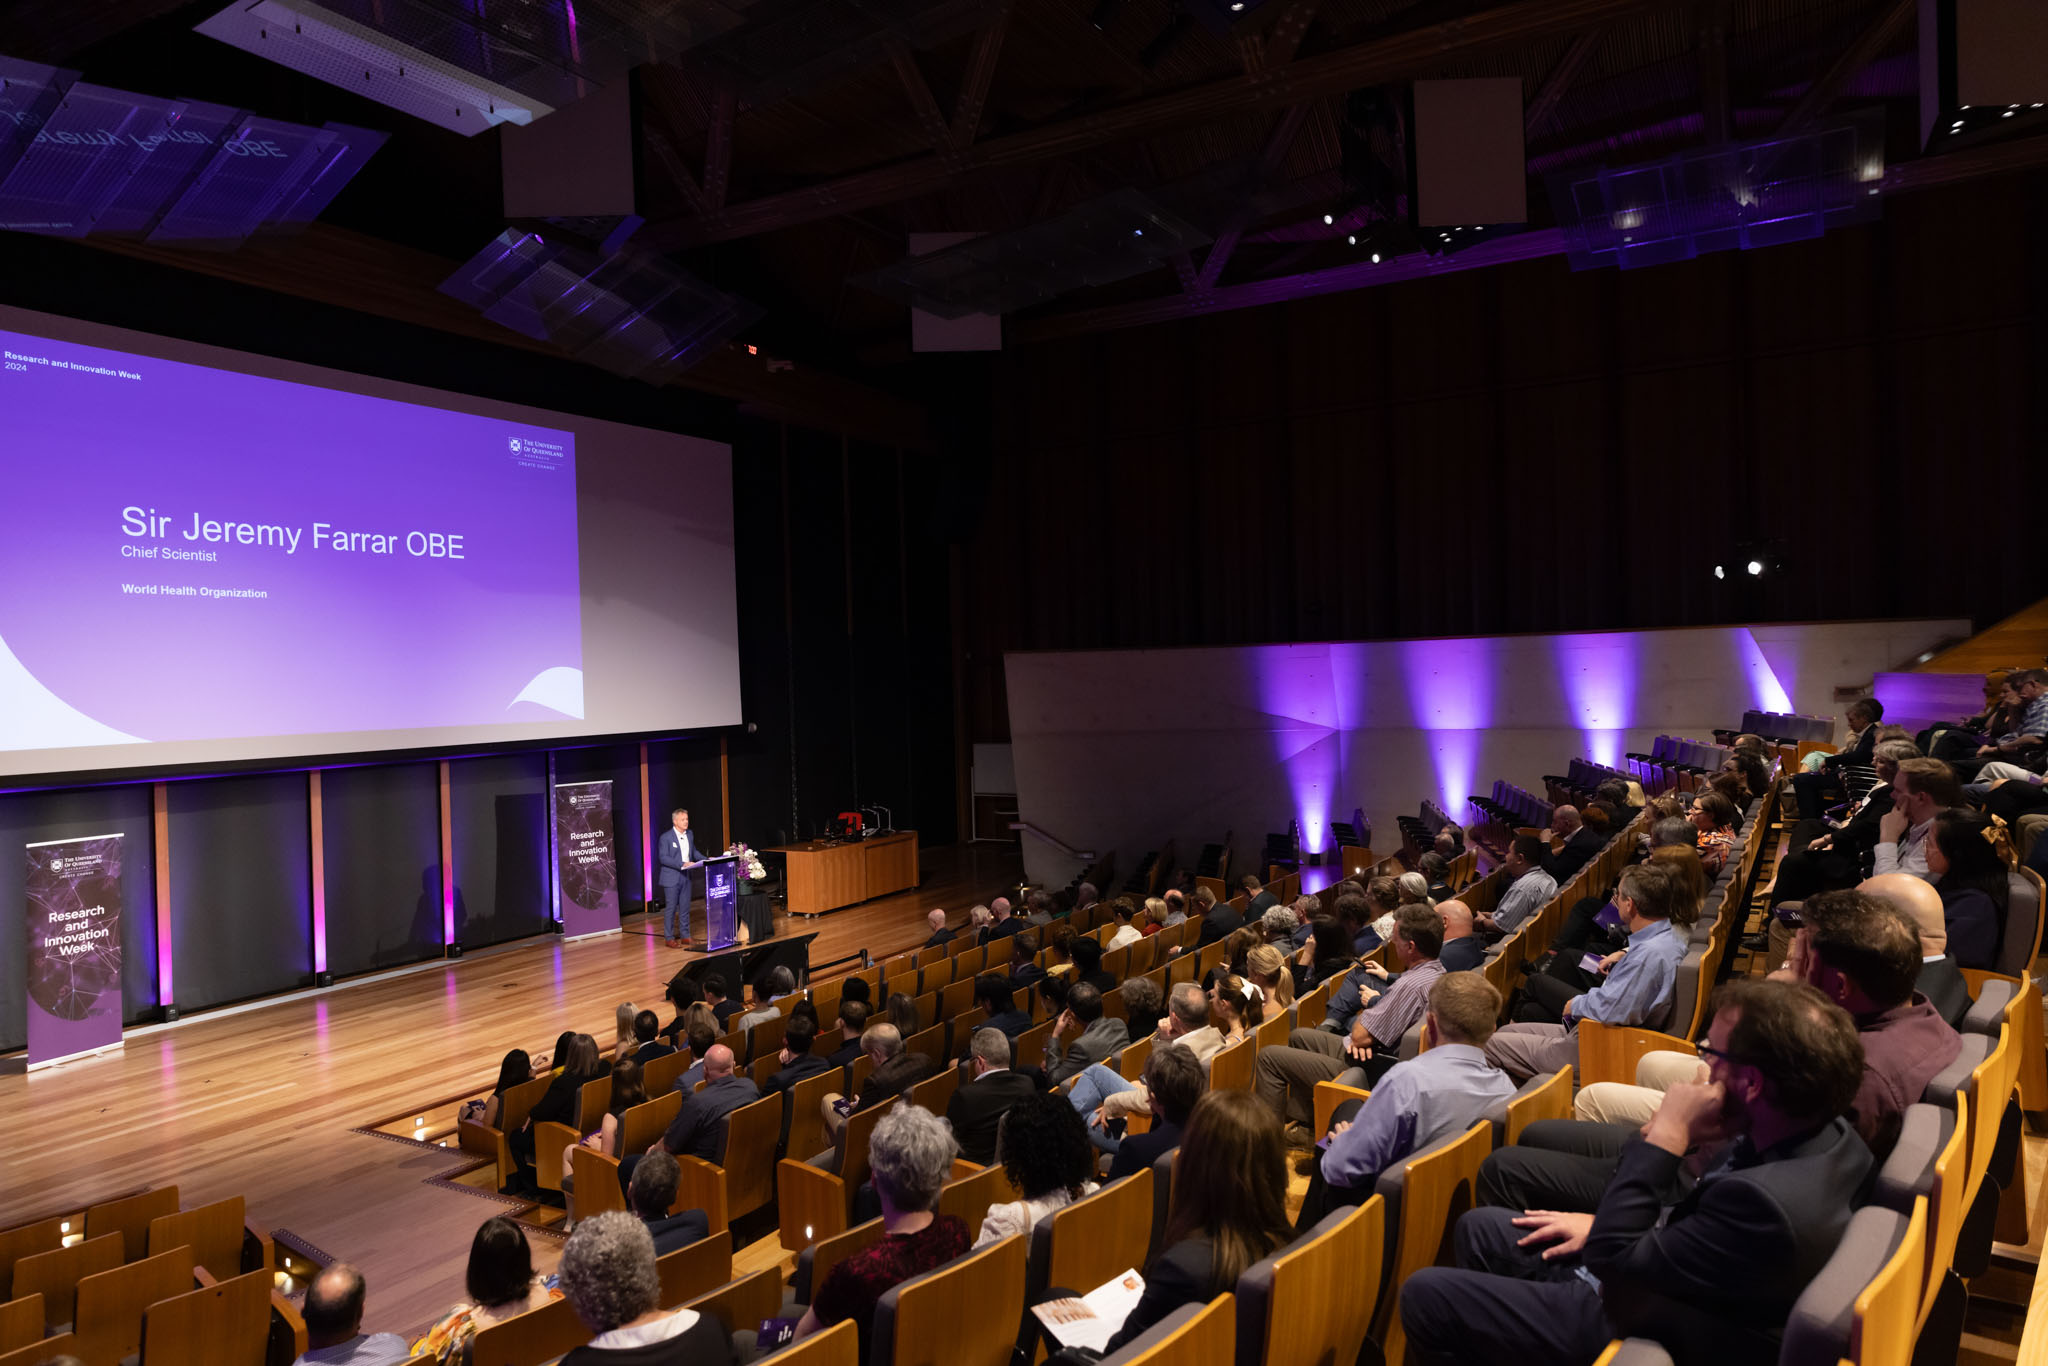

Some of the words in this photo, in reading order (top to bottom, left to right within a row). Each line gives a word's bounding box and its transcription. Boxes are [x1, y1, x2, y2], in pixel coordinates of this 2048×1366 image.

[4, 351, 49, 366] Research
[51, 359, 69, 369] and
[70, 362, 117, 377] Innovation
[118, 370, 142, 381] Week
[4, 361, 27, 372] 2024
[122, 506, 172, 538] Sir
[183, 512, 302, 554] Jeremy
[313, 522, 398, 554] Farrar
[406, 531, 465, 559] OBE
[121, 545, 159, 558] Chief
[161, 547, 217, 562] Scientist
[121, 583, 157, 595] World
[160, 585, 197, 596] Health
[199, 587, 268, 599] Organization
[570, 830, 604, 840] Research
[581, 839, 594, 847] and
[568, 846, 608, 857] Innovation
[578, 855, 599, 864] Week
[48, 905, 105, 923] Research
[65, 919, 88, 932] and
[44, 927, 109, 947] Innovation
[59, 942, 95, 956] Week
